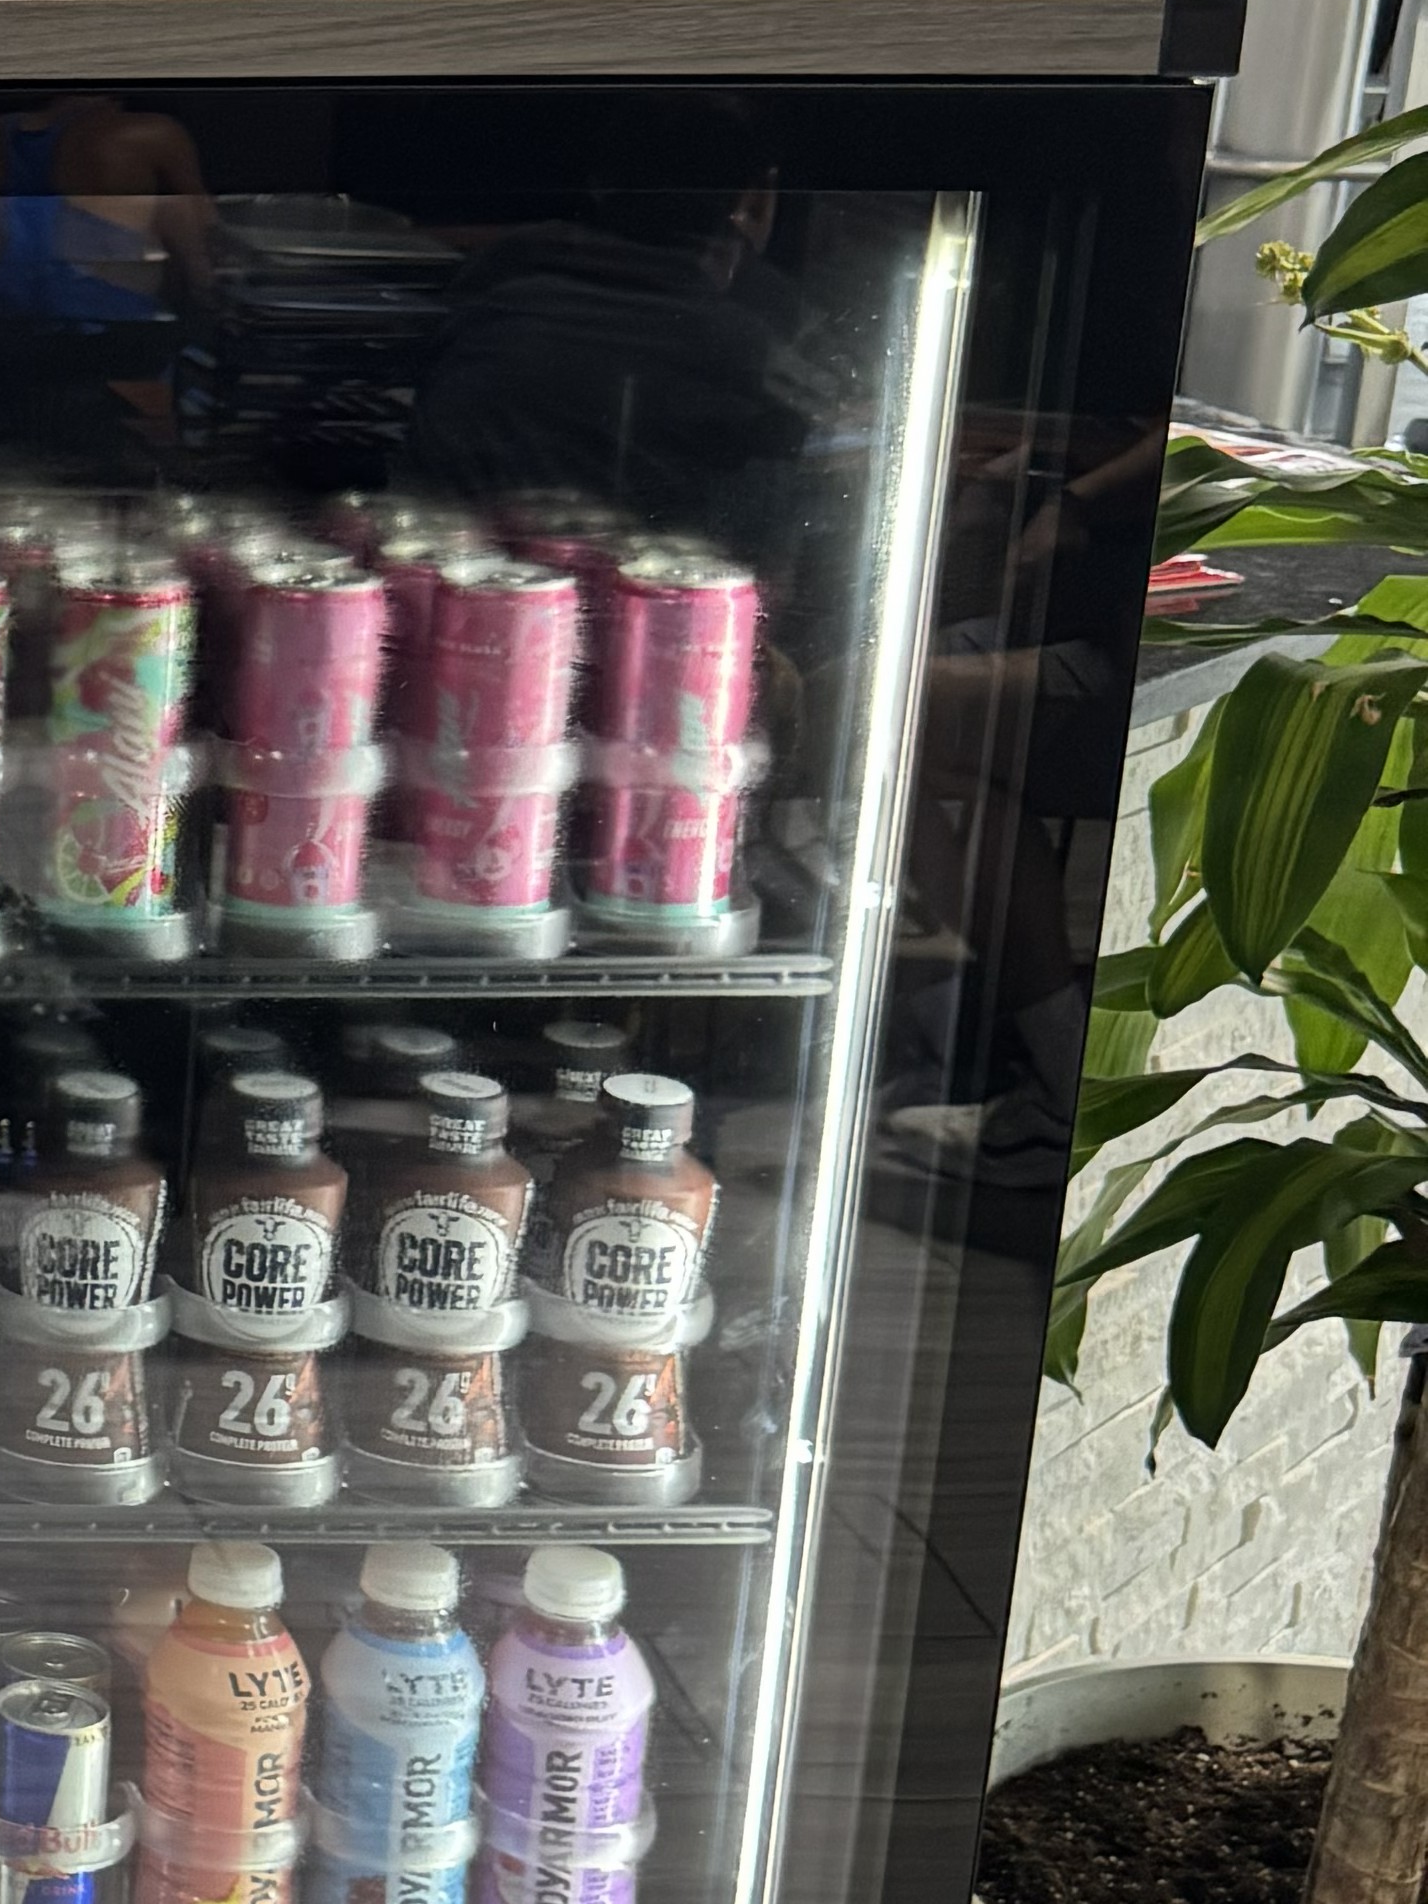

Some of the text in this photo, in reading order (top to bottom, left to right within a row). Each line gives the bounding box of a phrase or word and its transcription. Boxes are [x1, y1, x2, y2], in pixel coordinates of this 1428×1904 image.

[36, 1232, 121, 1283] CORE
[222, 1238, 312, 1284] CORE
[396, 1231, 487, 1283] CORE
[585, 1239, 676, 1286] CORE
[37, 1280, 120, 1311] POWER
[221, 1279, 307, 1315] POWER
[393, 1274, 483, 1311] POWER
[581, 1277, 672, 1314] POWER
[227, 1661, 305, 1699] LYTE
[44, 1820, 98, 1854] Bull
